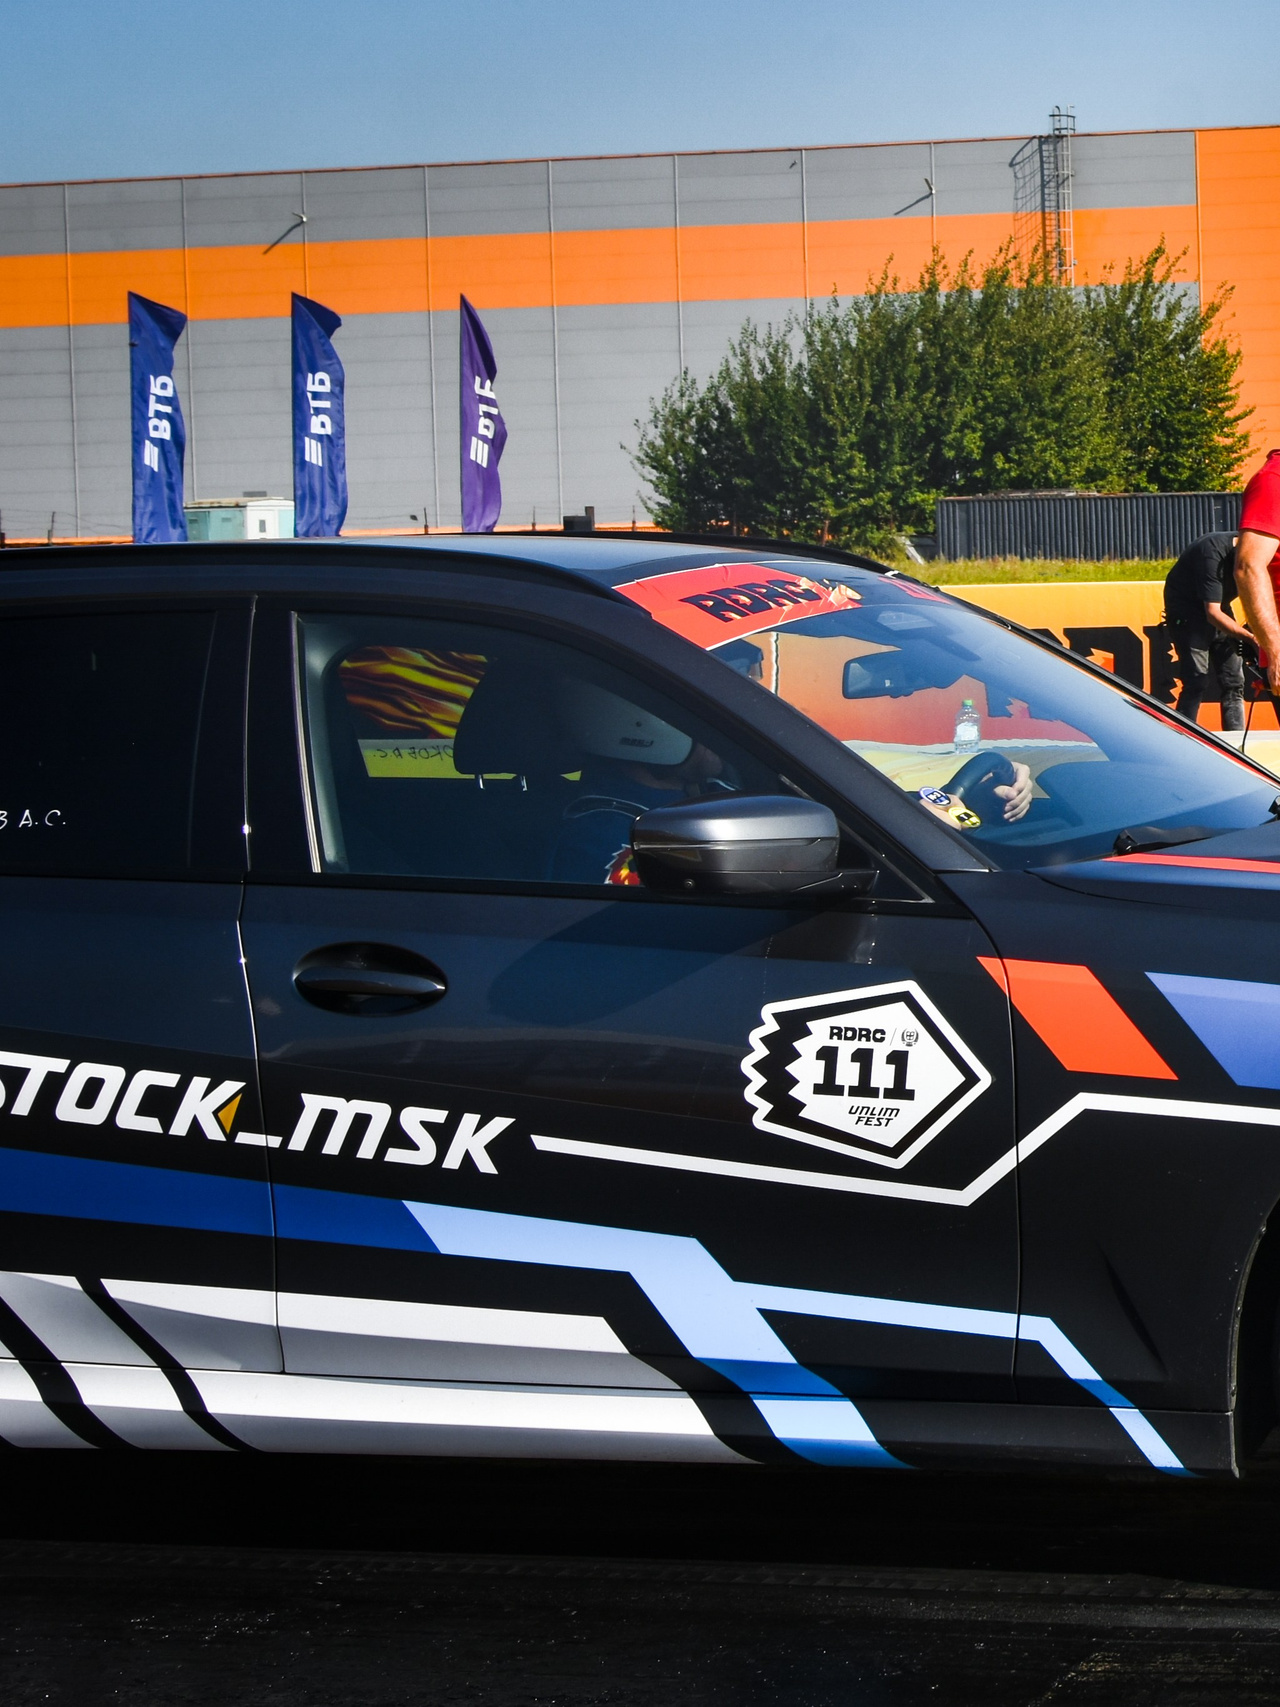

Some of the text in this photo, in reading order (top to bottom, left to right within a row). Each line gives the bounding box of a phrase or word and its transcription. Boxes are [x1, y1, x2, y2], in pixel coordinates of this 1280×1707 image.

[148, 374, 174, 441] ВТБ
[307, 371, 332, 435] ВТБ
[678, 579, 825, 623] RDRC
[829, 1026, 886, 1043] RDRC
[812, 1045, 916, 1101] 111
[0, 1051, 516, 1175] TOCK_MSK
[848, 1105, 901, 1118] UNLIM
[854, 1116, 894, 1128] FEST
